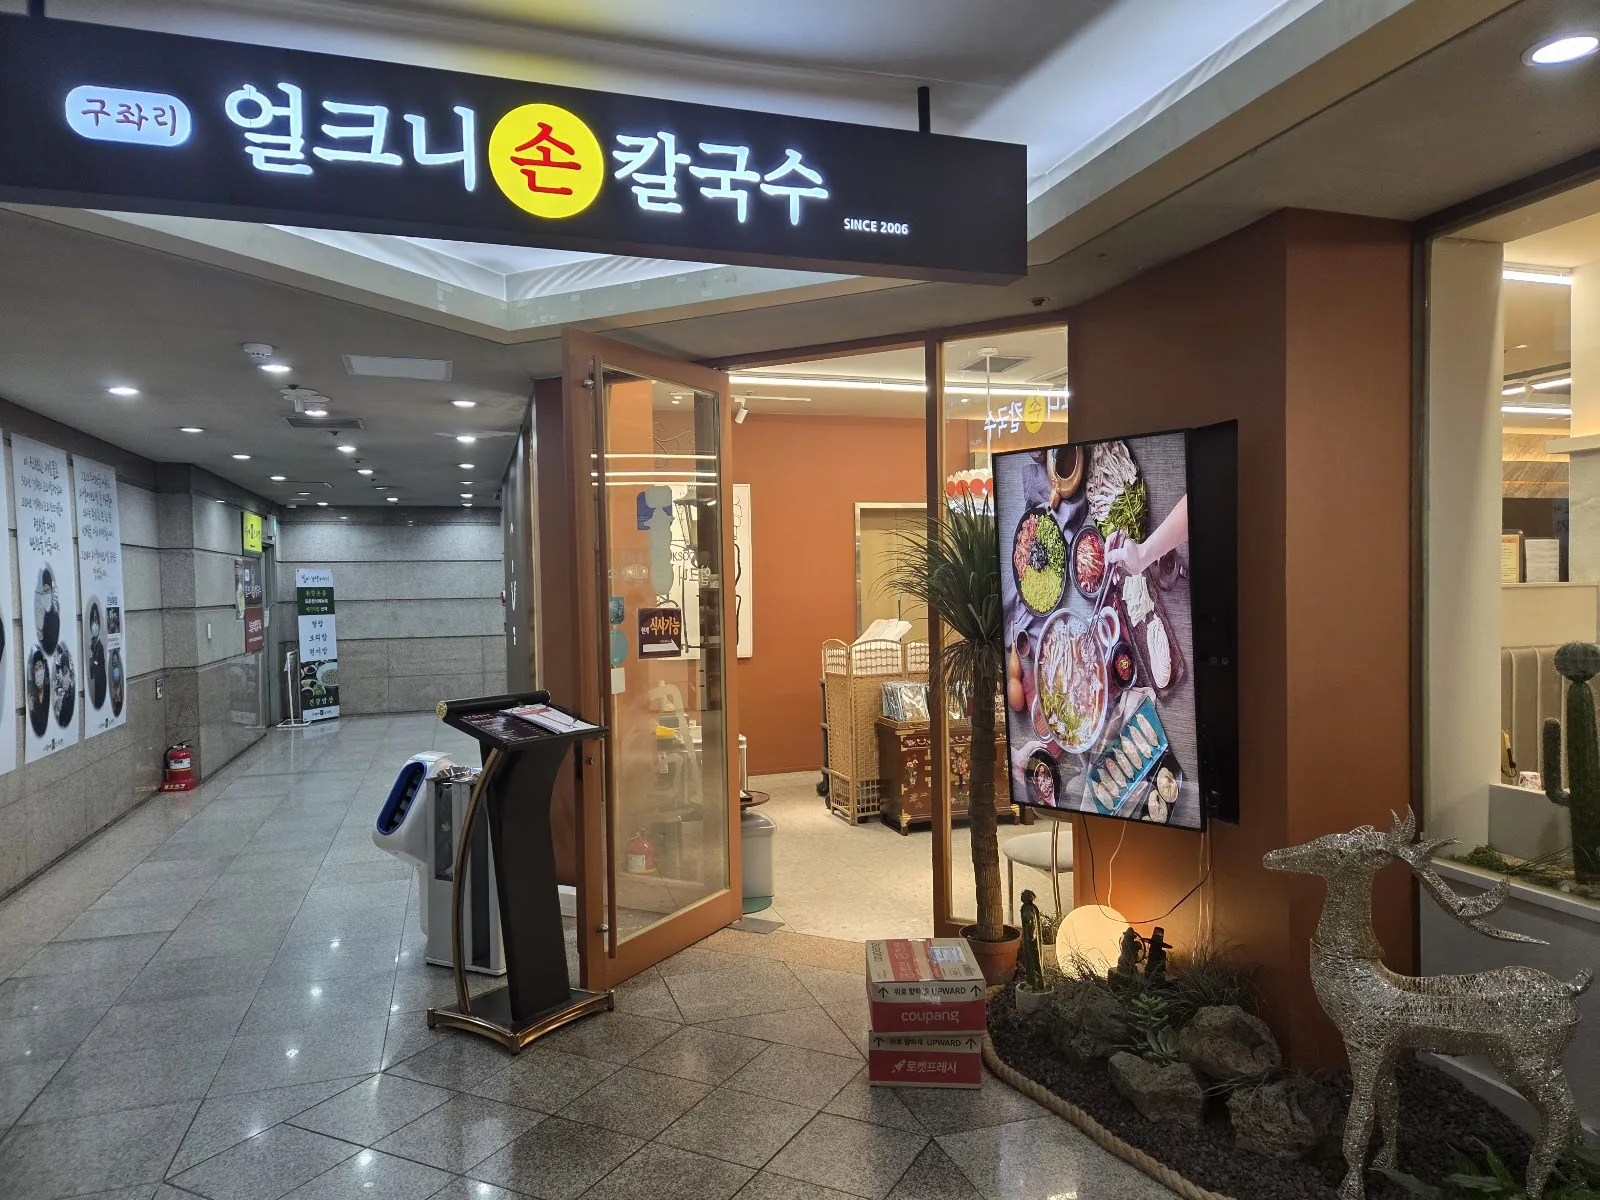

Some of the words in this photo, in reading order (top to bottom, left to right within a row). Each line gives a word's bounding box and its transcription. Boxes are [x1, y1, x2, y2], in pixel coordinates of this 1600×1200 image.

[80, 98, 178, 137] 구좌리
[224, 82, 478, 191] 얼크니
[509, 121, 582, 195] 손
[612, 131, 829, 226] 칼국수
[843, 217, 878, 234] SINCE
[879, 221, 909, 236] 2006
[649, 616, 681, 636] 식사가능
[931, 987, 966, 996] UPWARD
[901, 1010, 960, 1024] coupang
[926, 1039, 962, 1047] UPWARD
[906, 1060, 957, 1075] 로켓프레시
